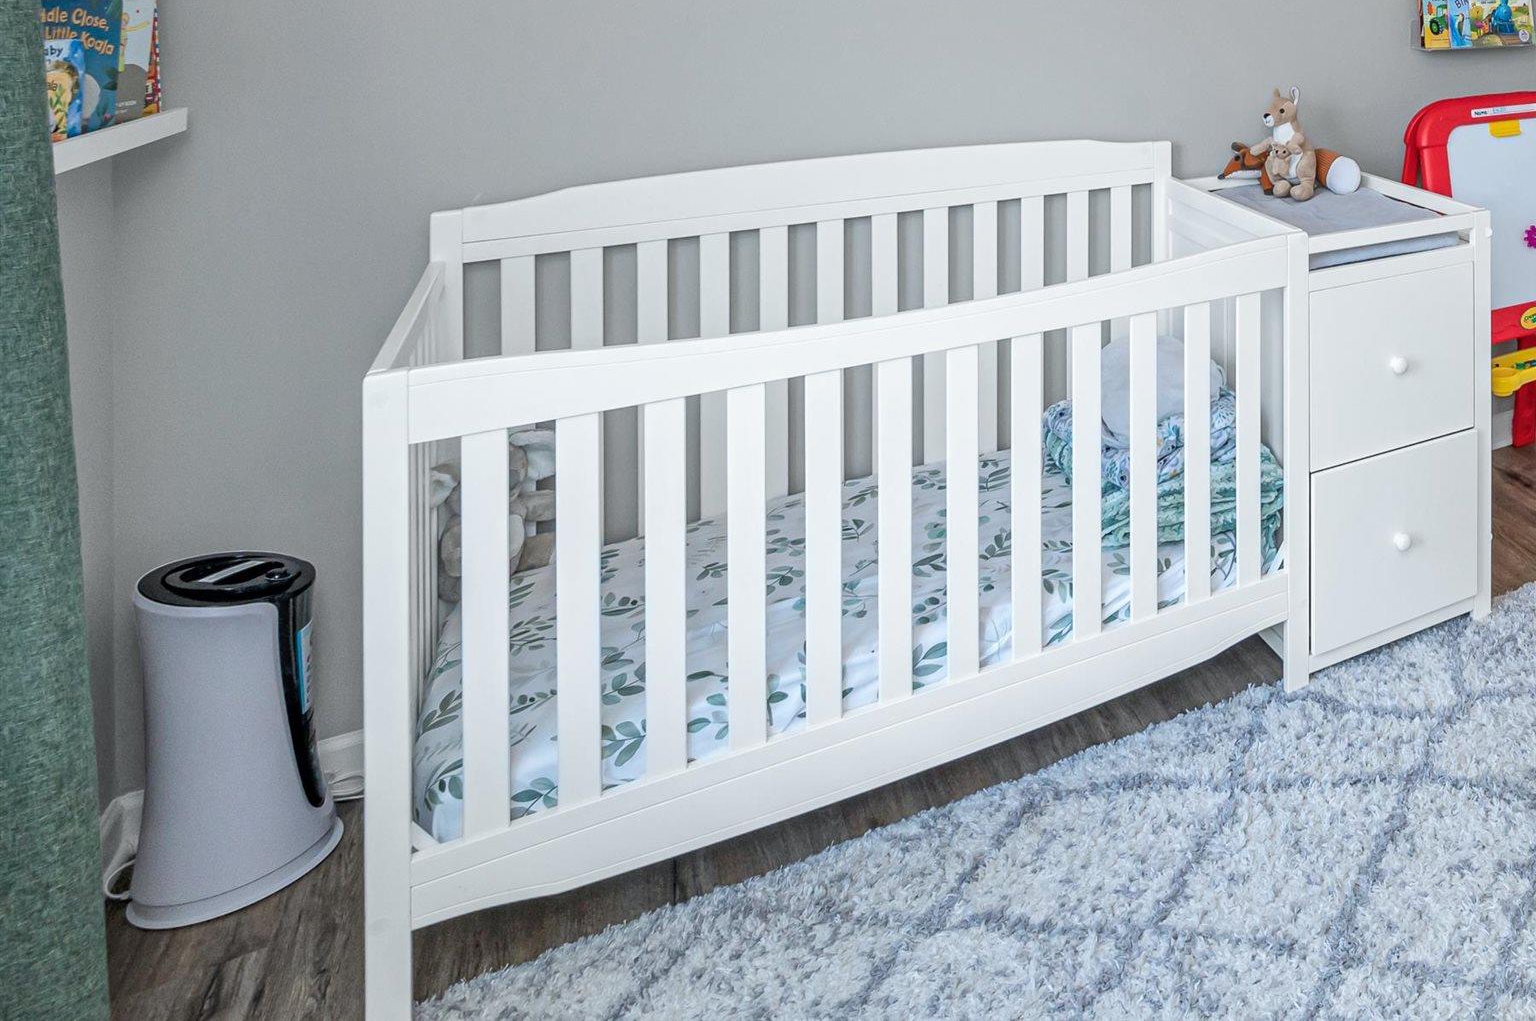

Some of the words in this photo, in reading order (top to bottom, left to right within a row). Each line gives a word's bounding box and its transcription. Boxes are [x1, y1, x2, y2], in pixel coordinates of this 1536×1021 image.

[71, 8, 109, 32] Close,
[45, 25, 78, 41] Little
[81, 31, 115, 56] Koala
